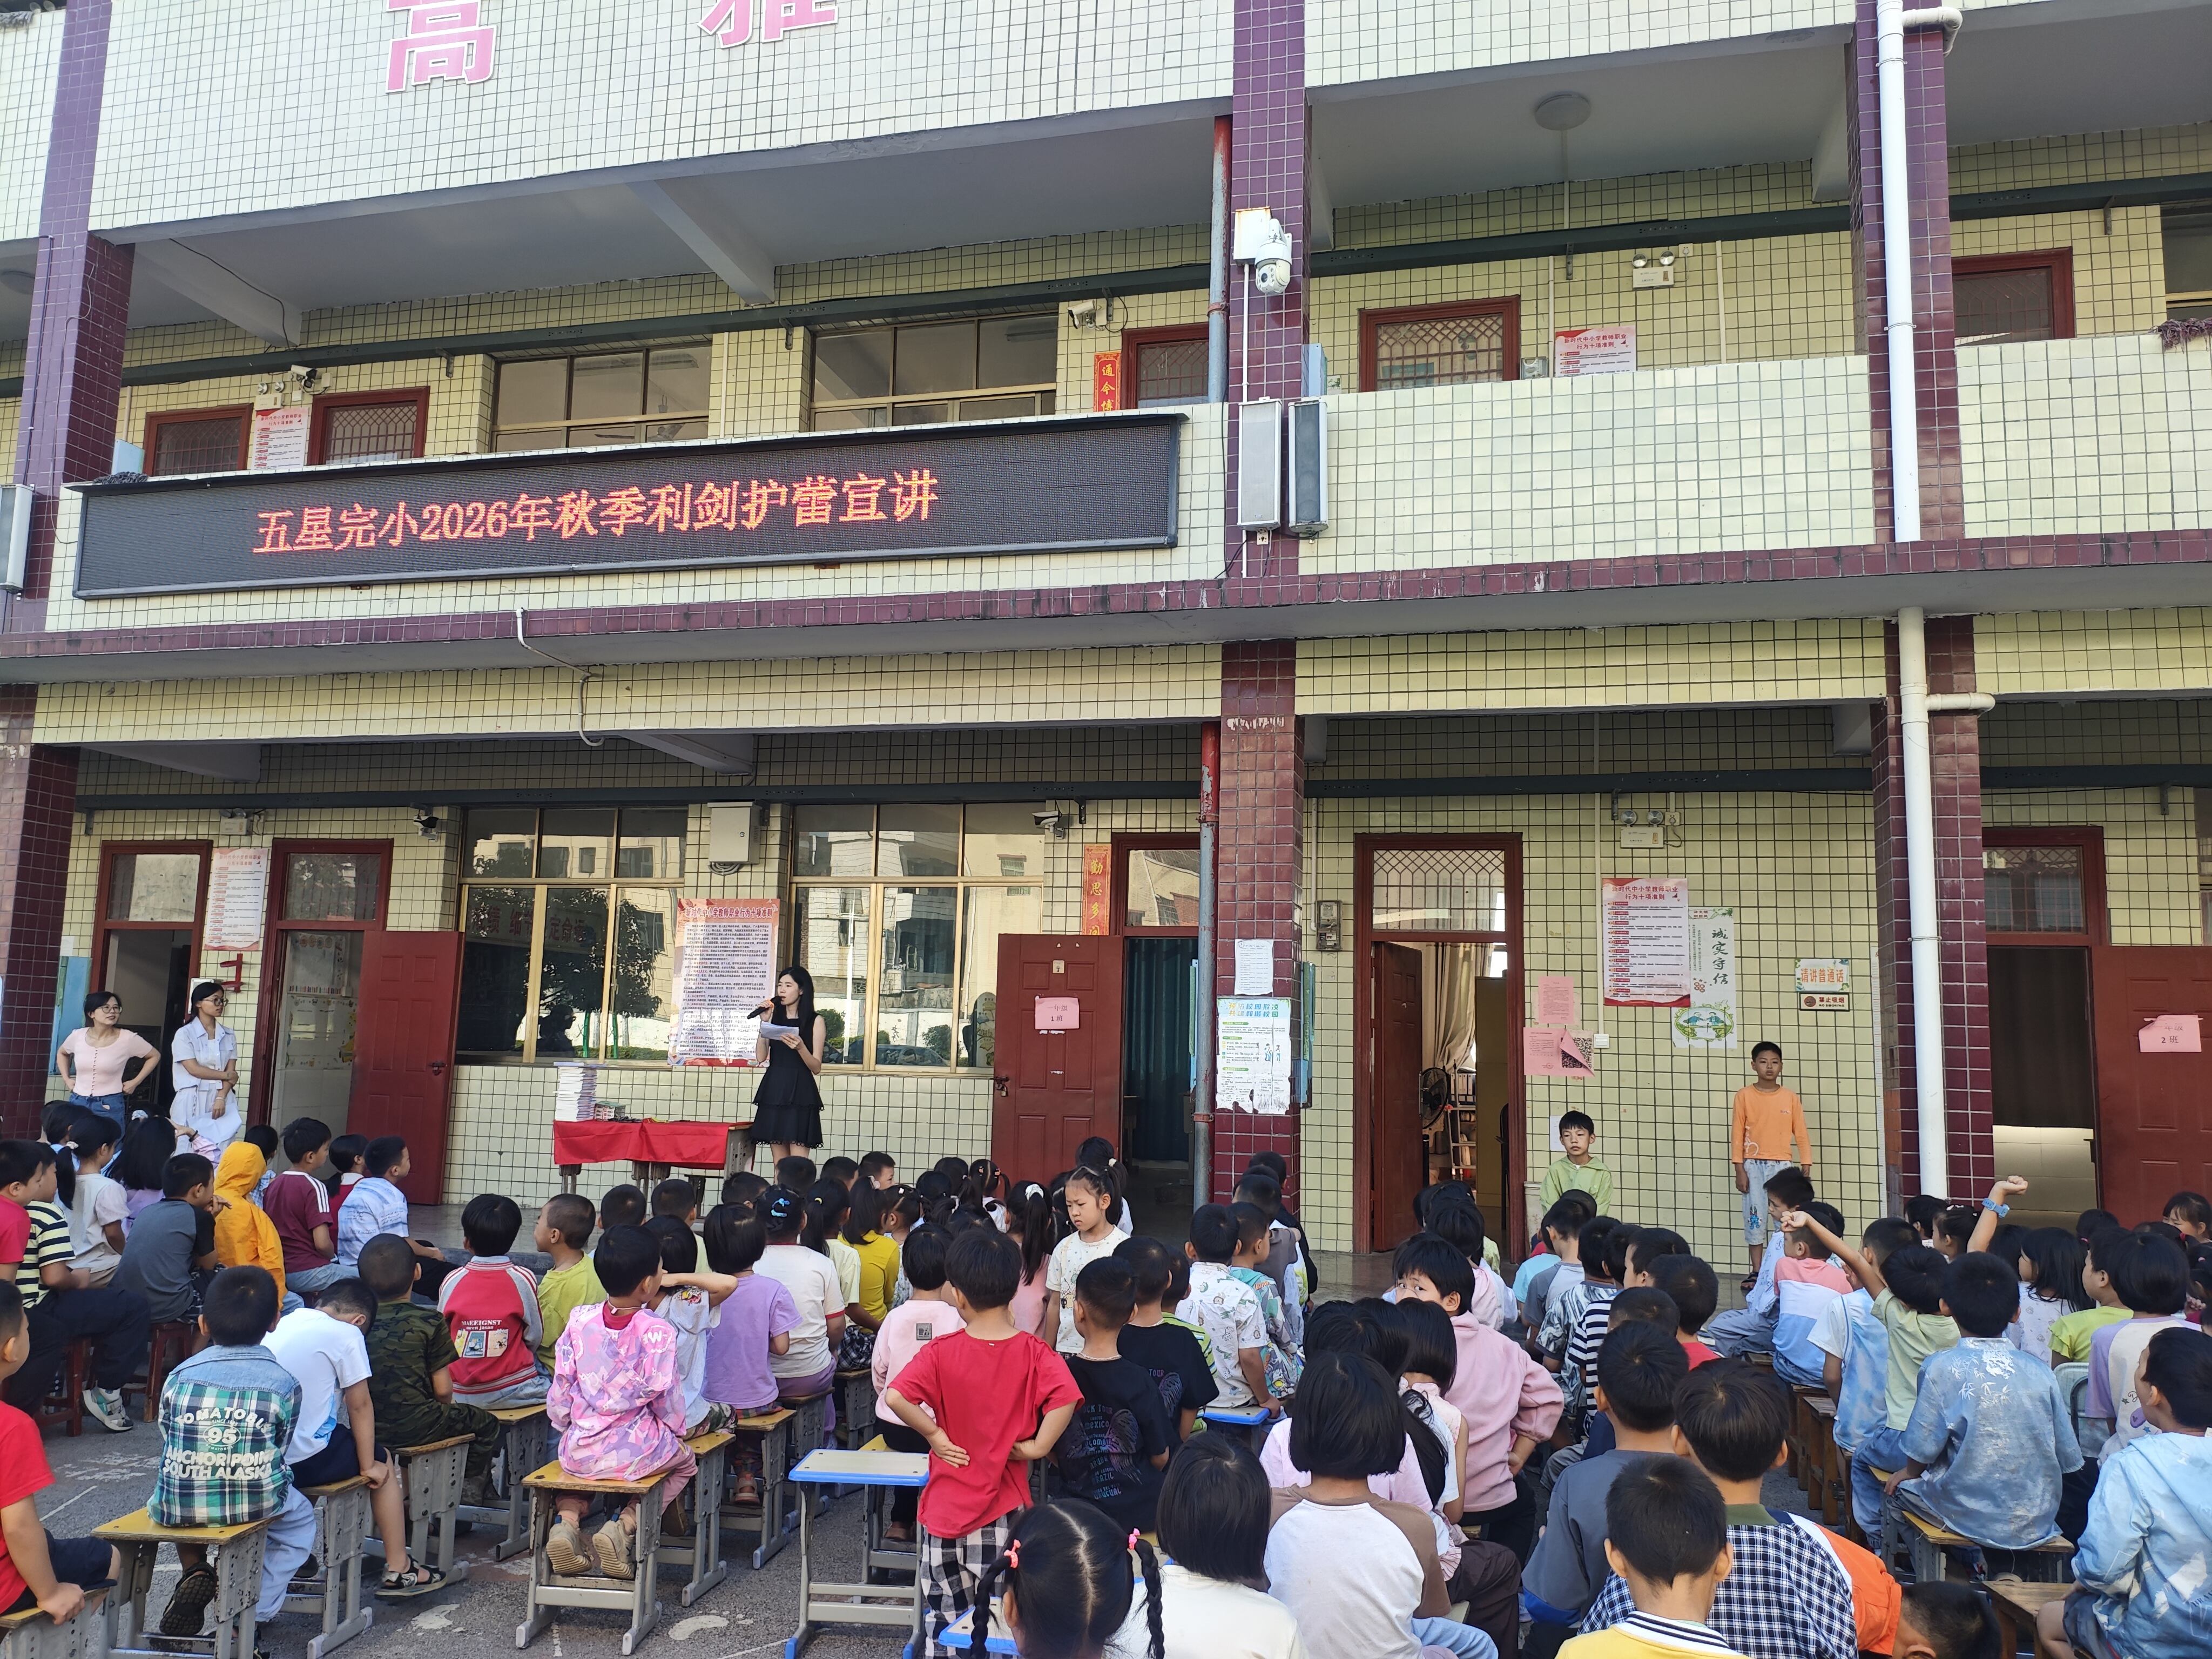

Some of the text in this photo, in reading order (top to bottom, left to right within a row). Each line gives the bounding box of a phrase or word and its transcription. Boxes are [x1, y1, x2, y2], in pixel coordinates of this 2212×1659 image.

[1564, 333, 1627, 343] 新时代中小学教师职业
[1577, 341, 1614, 349] 行为十项准则
[253, 468, 940, 554] 五星完小2026年秋季利剑护蕾宣讲
[686, 907, 773, 918] 新时代中小学教师职业行为十项准则
[1711, 928, 1728, 984] 诚实守信
[1801, 968, 1844, 982] 请讲普通话
[207, 1427, 237, 1444] 95
[165, 1445, 227, 1467] ANCHOR
[163, 1459, 273, 1480] SOUTH ALASKA
